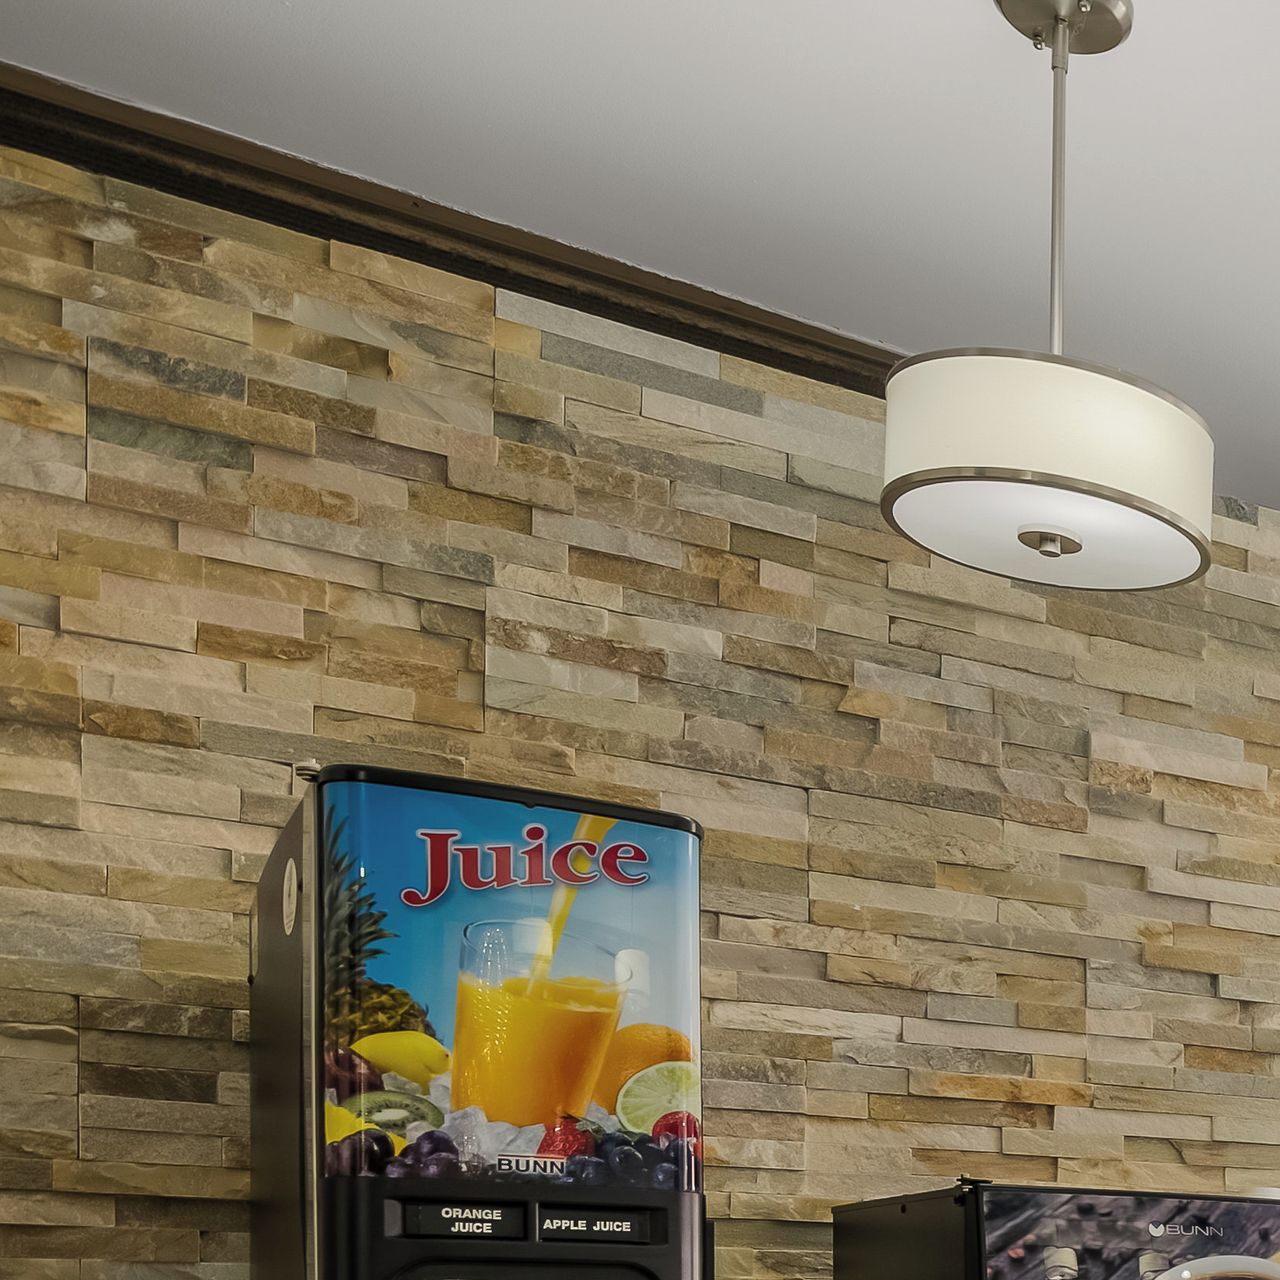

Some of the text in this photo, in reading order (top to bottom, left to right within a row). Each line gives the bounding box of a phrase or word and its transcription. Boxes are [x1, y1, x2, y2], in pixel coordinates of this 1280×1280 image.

[401, 823, 649, 907] Juice
[497, 1158, 566, 1175] BUNN
[441, 1207, 502, 1220] ORANGE
[451, 1222, 493, 1233] JUICE
[543, 1219, 631, 1232] APPLE JUICE
[1166, 1224, 1224, 1237] BUNN
